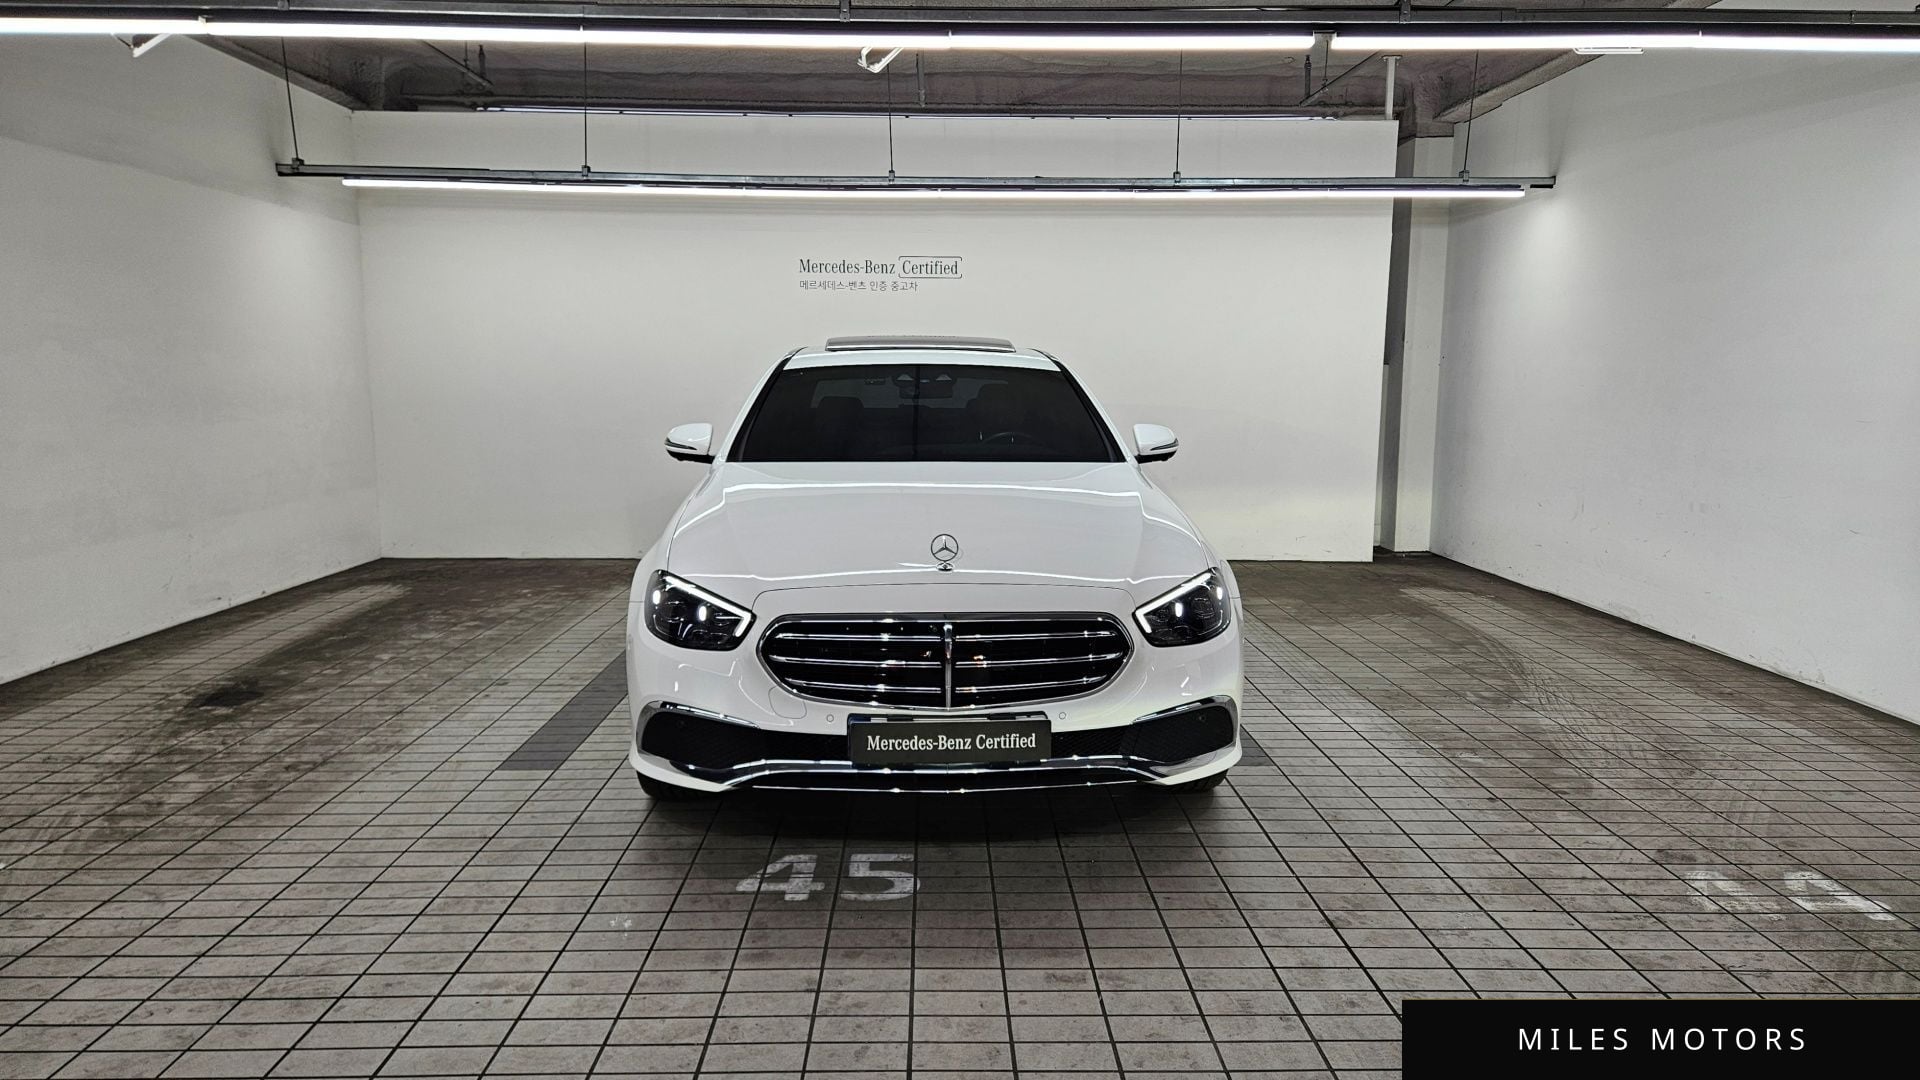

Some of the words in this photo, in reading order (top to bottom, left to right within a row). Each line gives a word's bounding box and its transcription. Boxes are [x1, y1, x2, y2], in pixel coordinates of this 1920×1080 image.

[799, 258, 896, 274] Mercedes-Benz
[902, 260, 958, 275] Certified
[799, 280, 867, 291] 메르세데스-벤츠
[869, 281, 887, 291] 인증
[890, 281, 918, 291] 중고차
[867, 734, 971, 751] Mercedes-Benz
[975, 733, 1036, 749] Certified
[736, 854, 921, 901] 45
